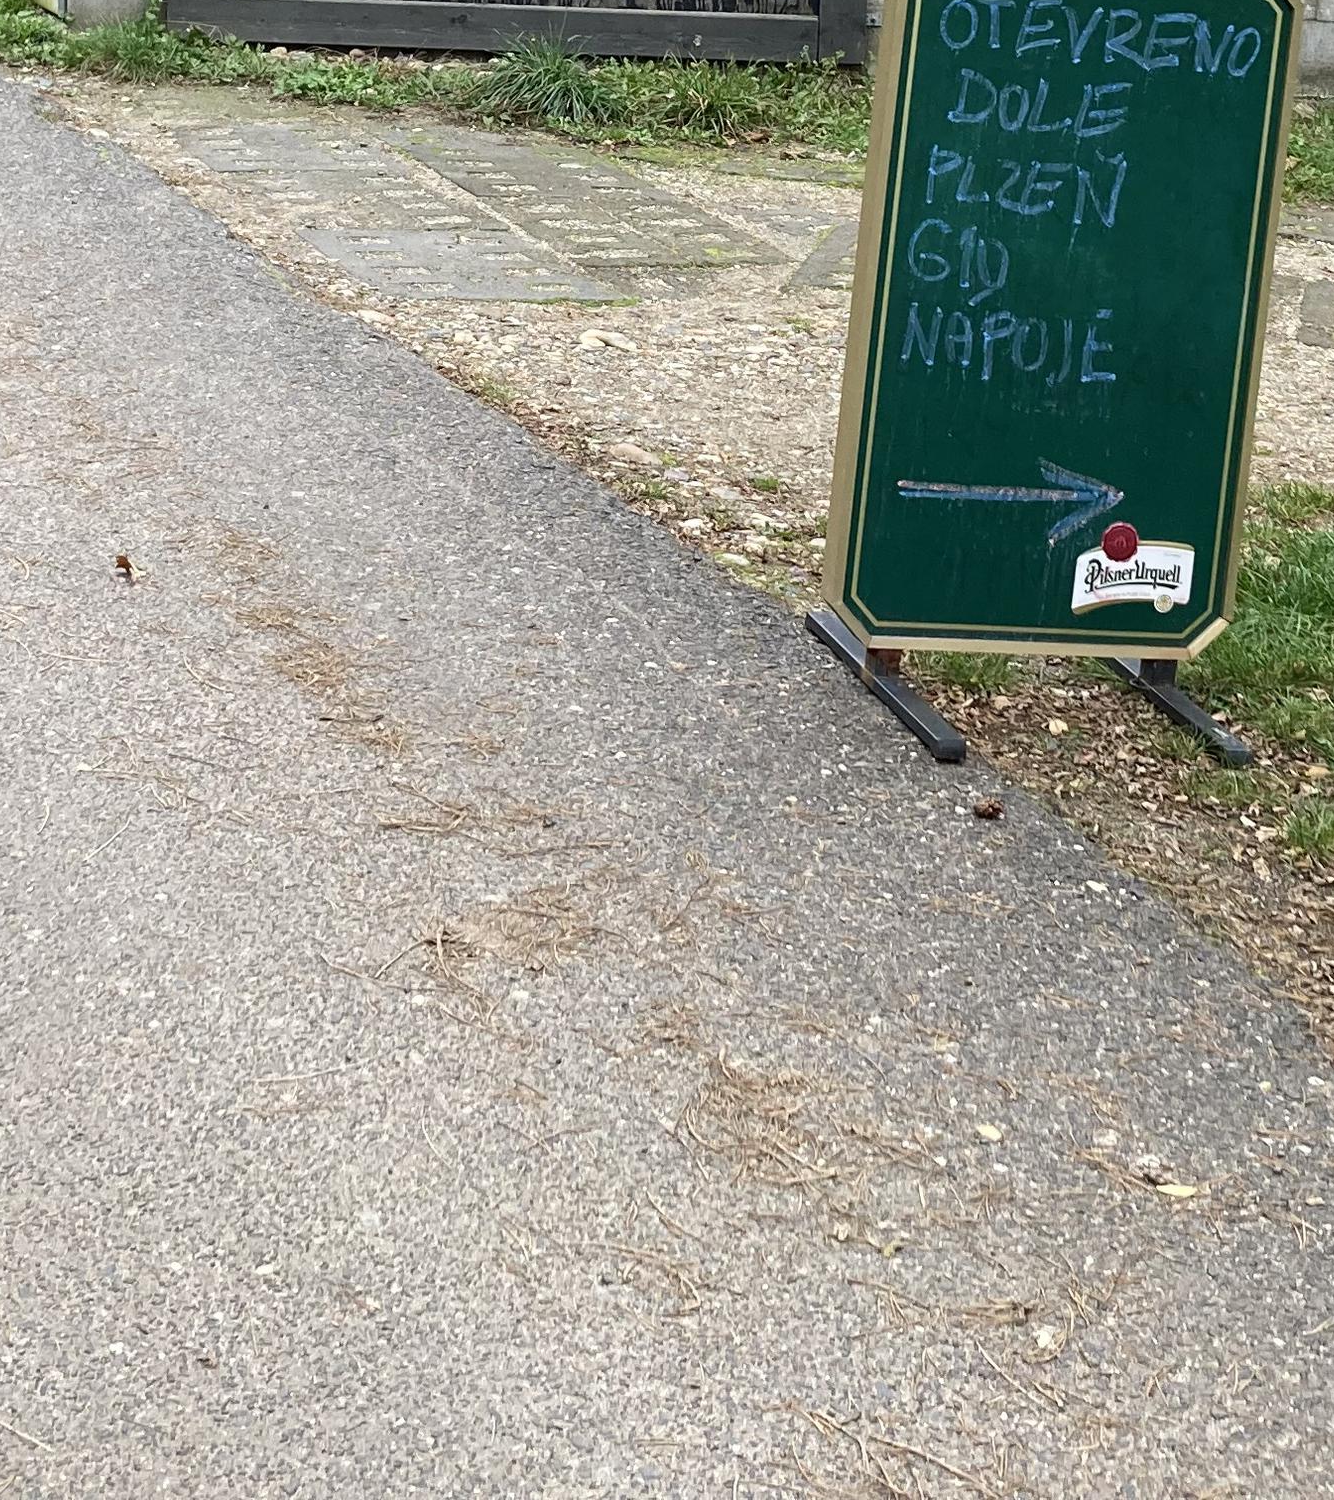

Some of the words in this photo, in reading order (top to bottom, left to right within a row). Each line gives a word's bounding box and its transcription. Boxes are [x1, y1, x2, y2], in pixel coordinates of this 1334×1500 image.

[947, 68, 1133, 138] DOLE
[1084, 558, 1136, 593] Pilsner
[1134, 559, 1182, 590] Urquell
